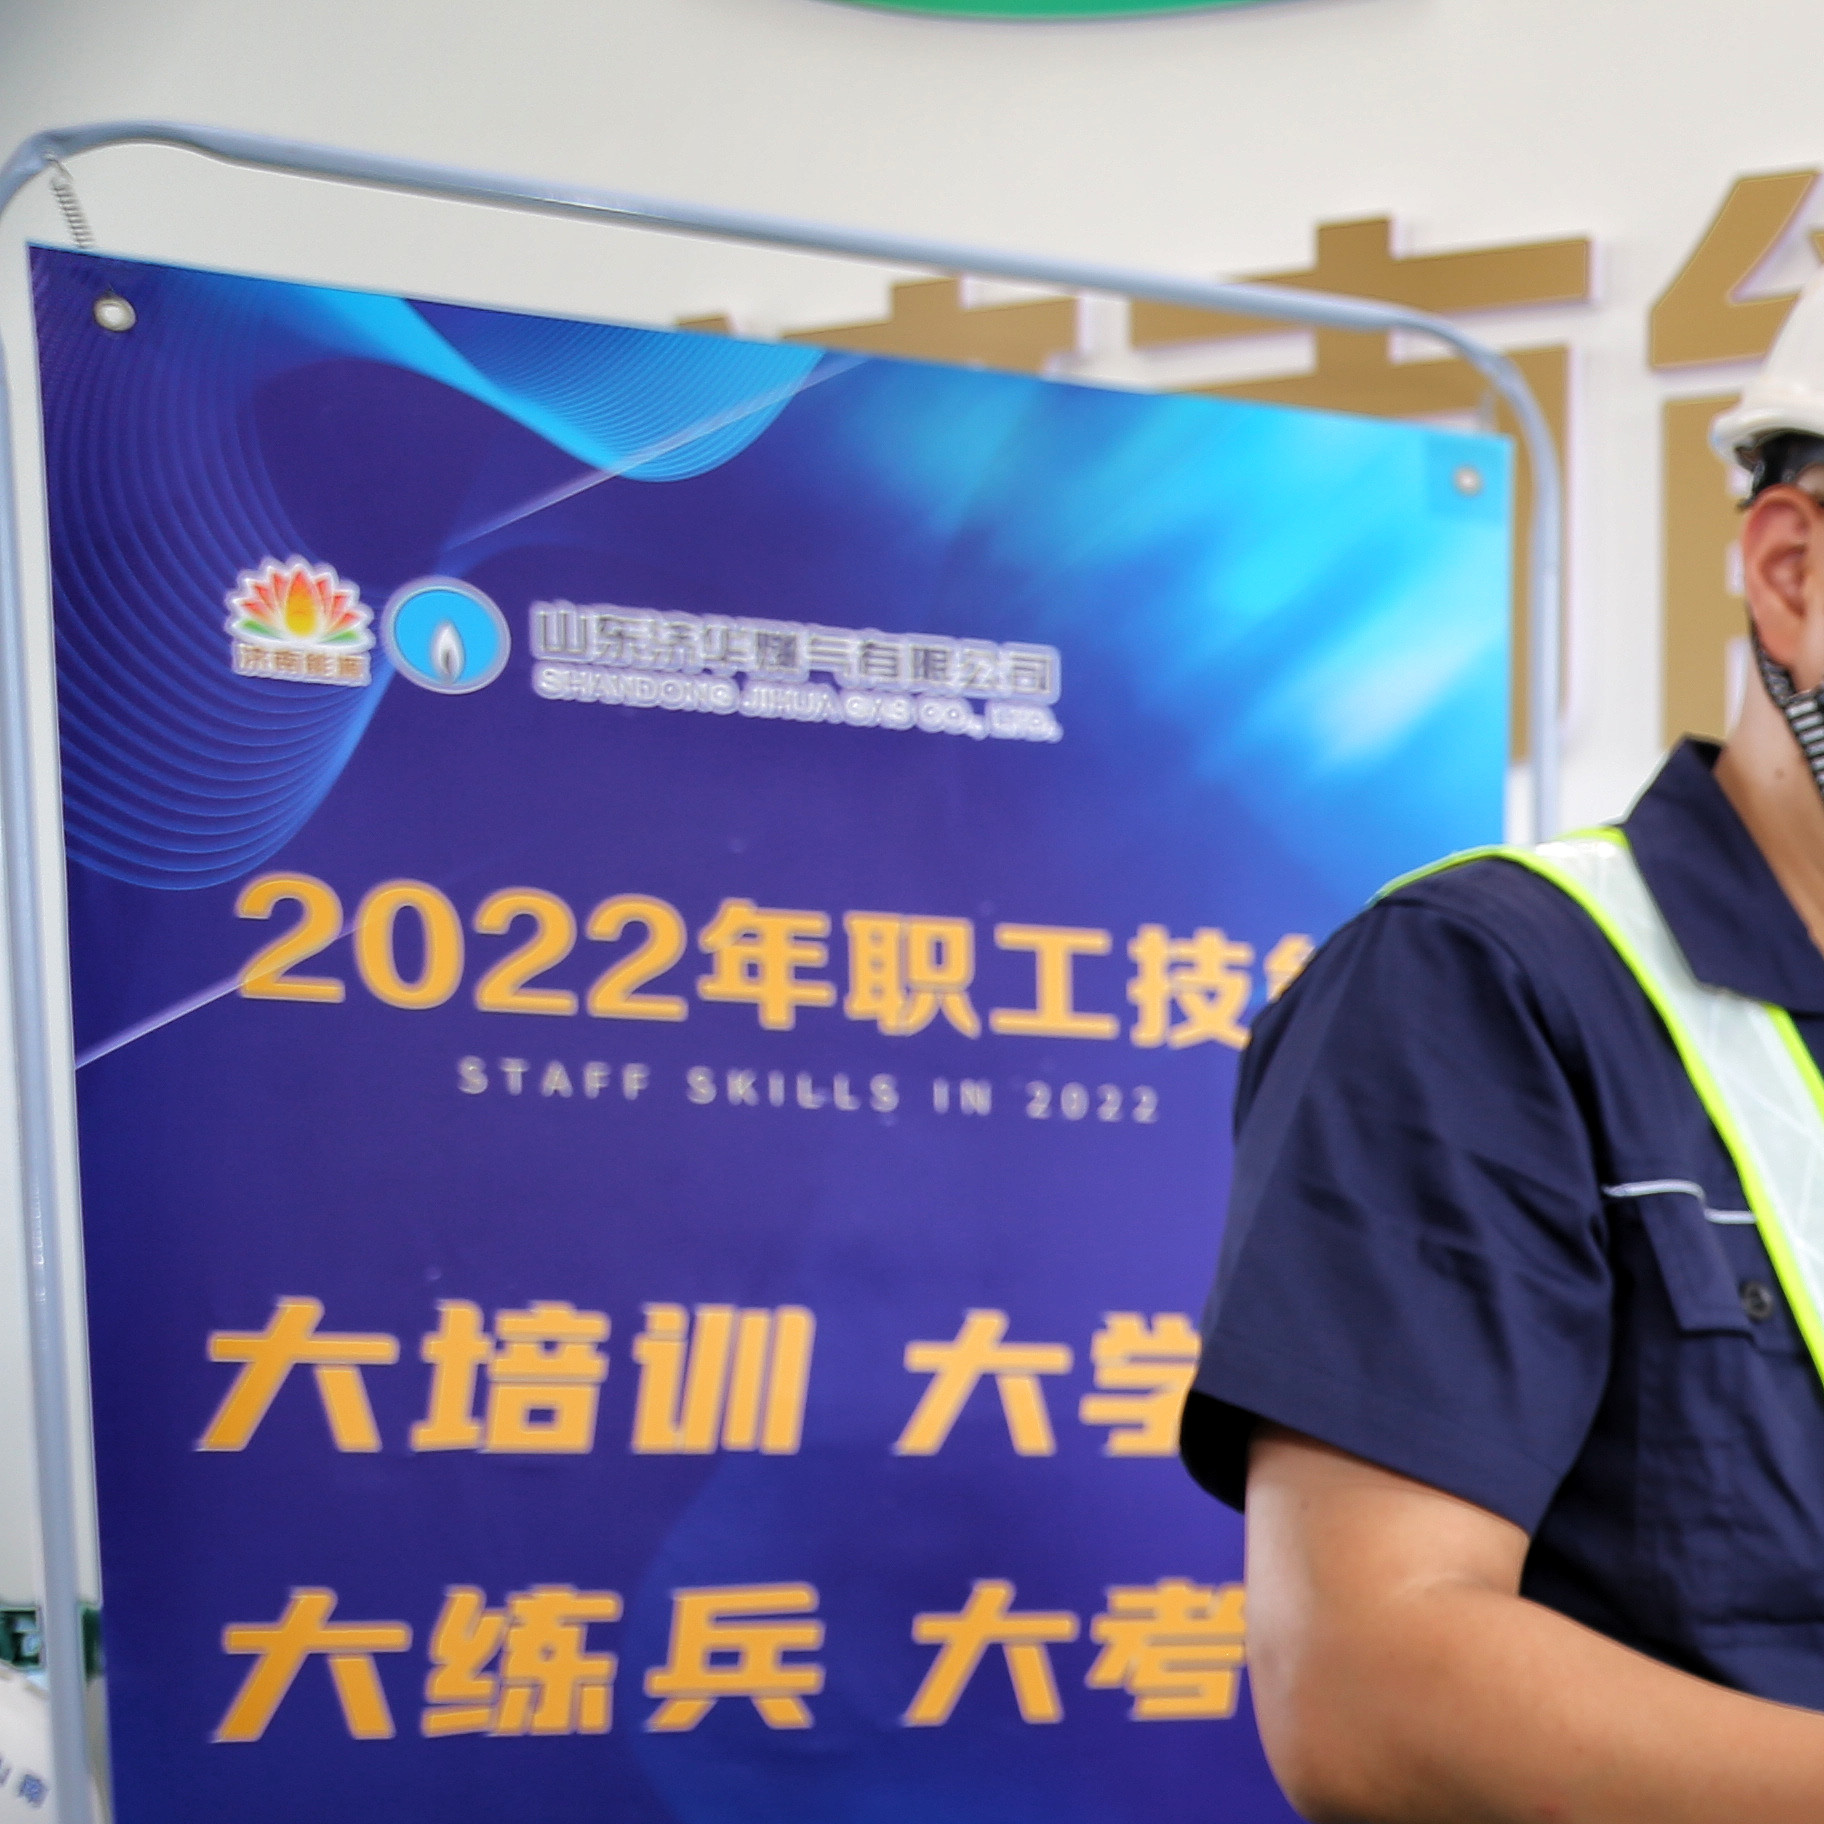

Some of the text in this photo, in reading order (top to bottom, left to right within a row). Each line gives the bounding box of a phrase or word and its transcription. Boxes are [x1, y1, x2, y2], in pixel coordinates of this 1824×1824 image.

[533, 603, 1058, 698] 山东济华燃气有限公司
[537, 663, 738, 712] SHANDONG
[232, 874, 1318, 1052] 2022年职工技
[457, 1055, 1158, 1125] STAFF SKILLS IN 2022
[198, 1295, 816, 1456] 大培训
[212, 1578, 1247, 1742] 大练兵 大考
